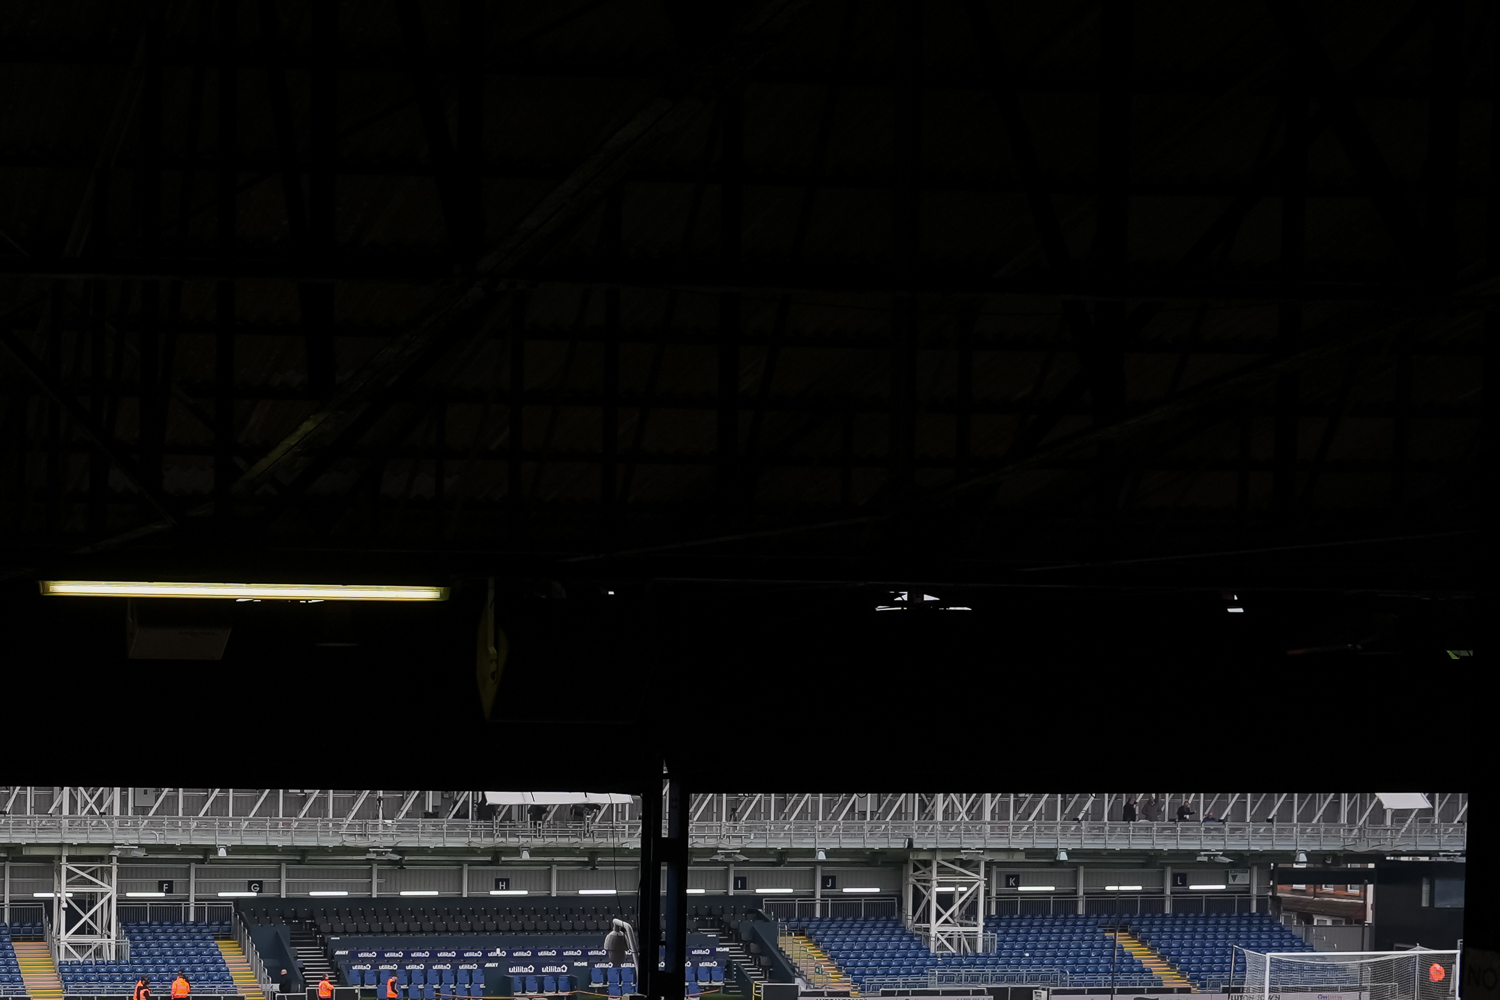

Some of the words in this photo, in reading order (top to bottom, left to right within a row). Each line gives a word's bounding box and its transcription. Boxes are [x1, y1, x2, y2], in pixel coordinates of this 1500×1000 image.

[827, 879, 832, 888] J
[1010, 878, 1016, 886] K
[1178, 876, 1182, 884] L
[163, 884, 168, 892] F
[251, 883, 259, 892] G
[499, 881, 505, 890] H
